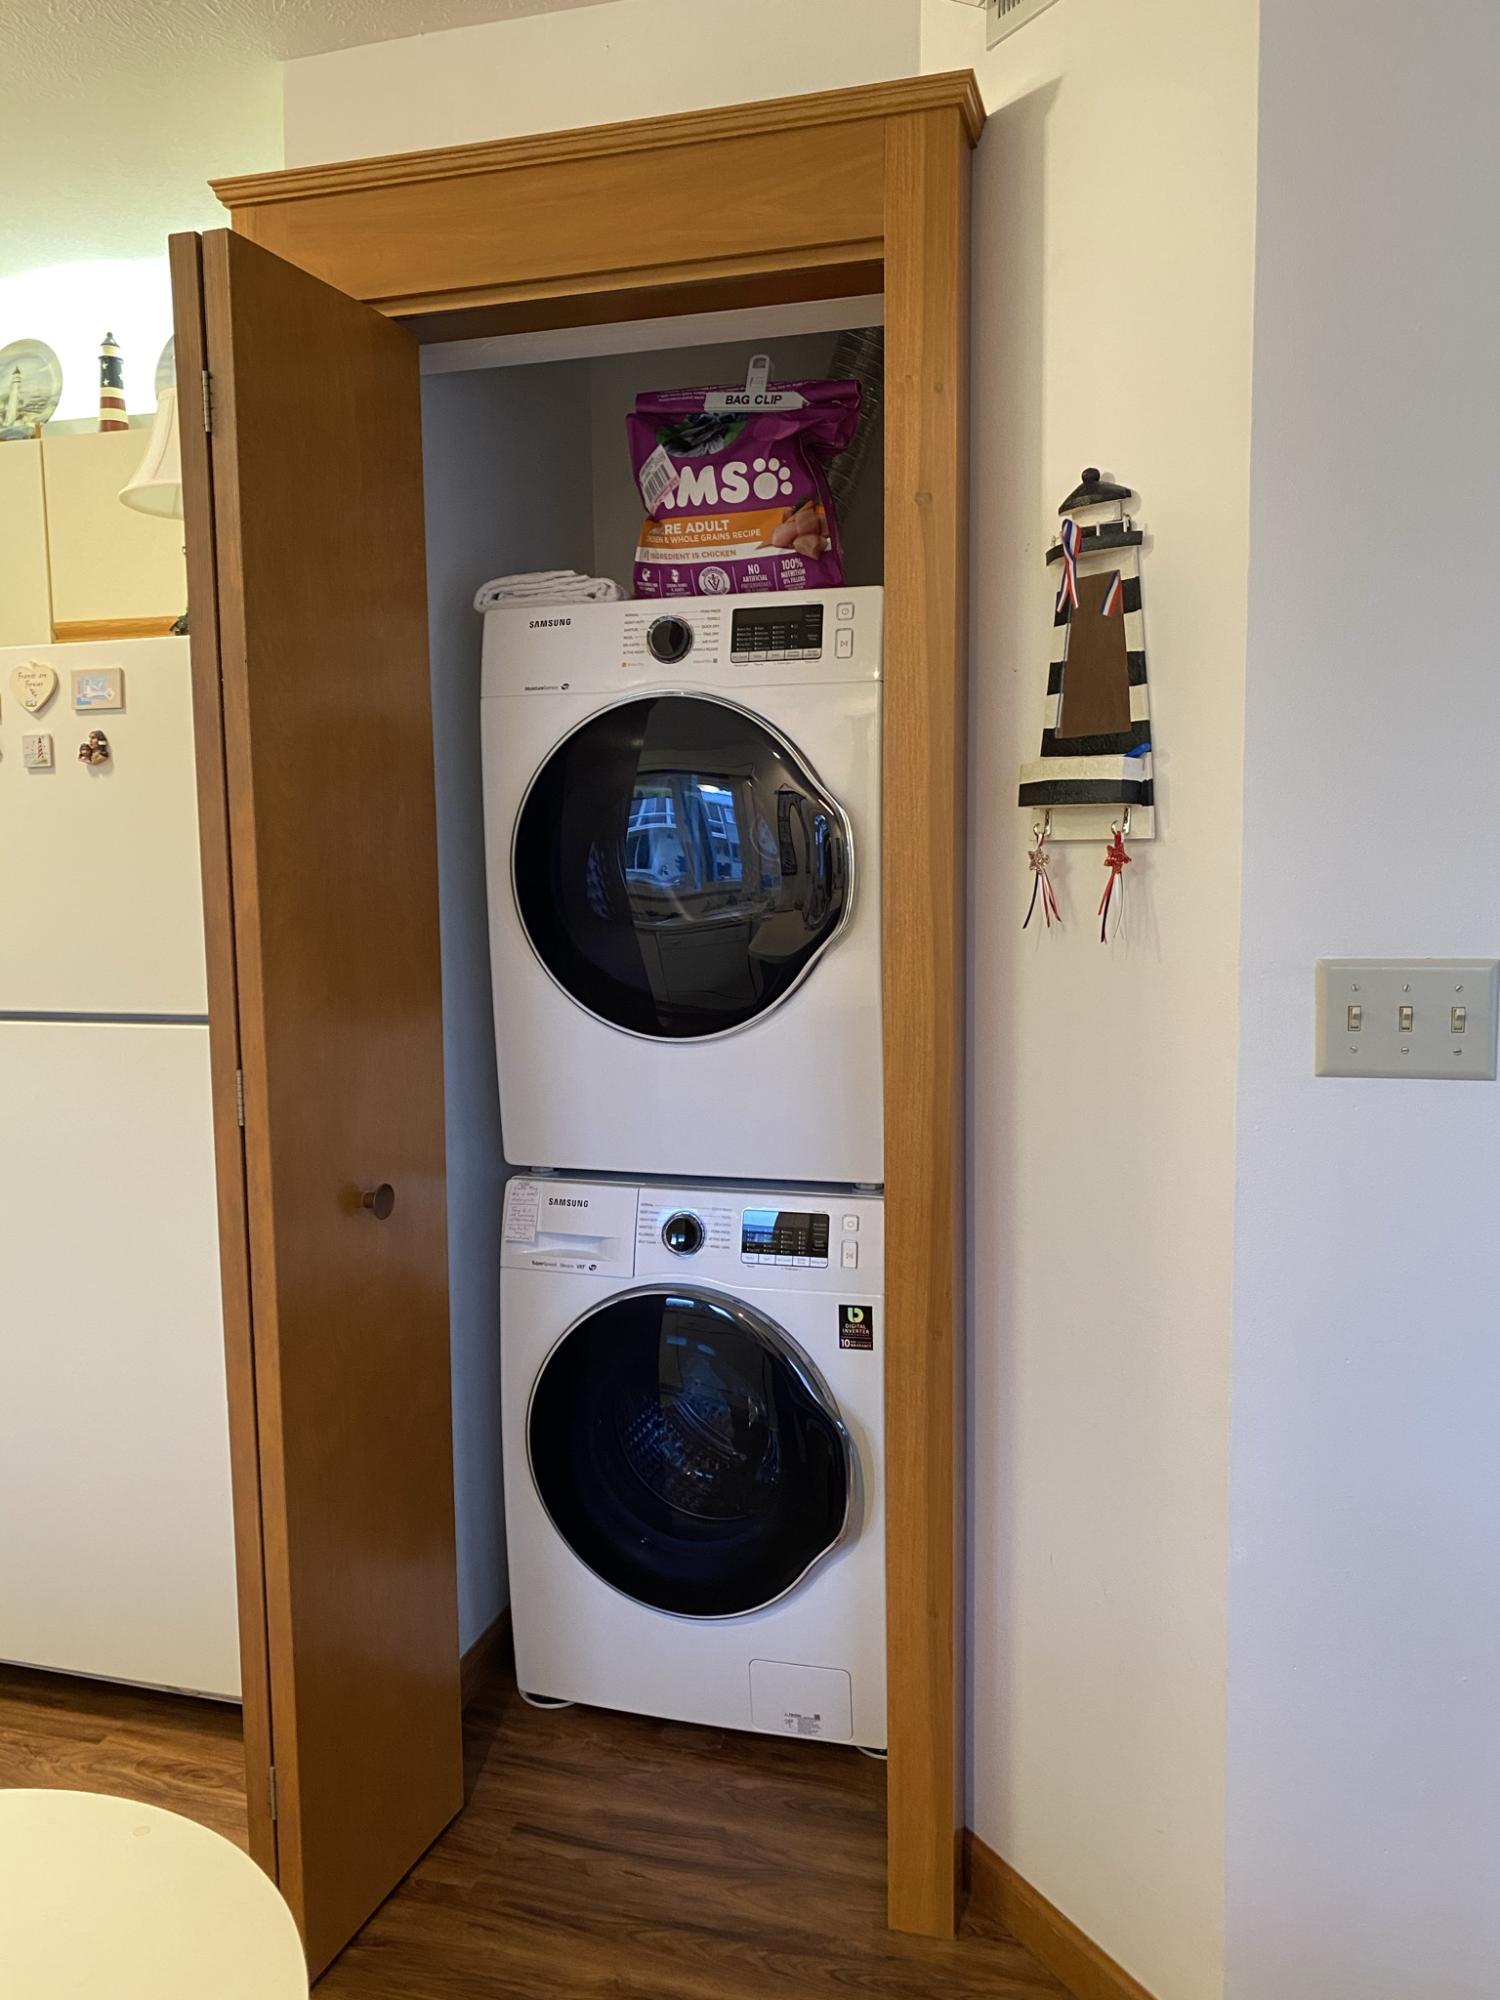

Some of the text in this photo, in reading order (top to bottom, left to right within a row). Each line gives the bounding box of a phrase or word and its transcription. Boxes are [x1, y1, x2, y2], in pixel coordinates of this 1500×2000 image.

[725, 394, 783, 405] BAG CLIP
[662, 461, 750, 509] MS
[686, 520, 730, 534] ADULT
[670, 534, 699, 544] WHOLE
[701, 532, 730, 542] GRAINS
[733, 528, 761, 538] RECIPE
[692, 551, 699, 559] IS
[701, 549, 736, 559] CHICKEN
[747, 563, 760, 575] NO
[781, 557, 803, 570] 100%
[529, 618, 572, 629] SAMSUNG
[548, 1197, 589, 1208] SAMSUNG
[841, 1338, 851, 1348] 10
